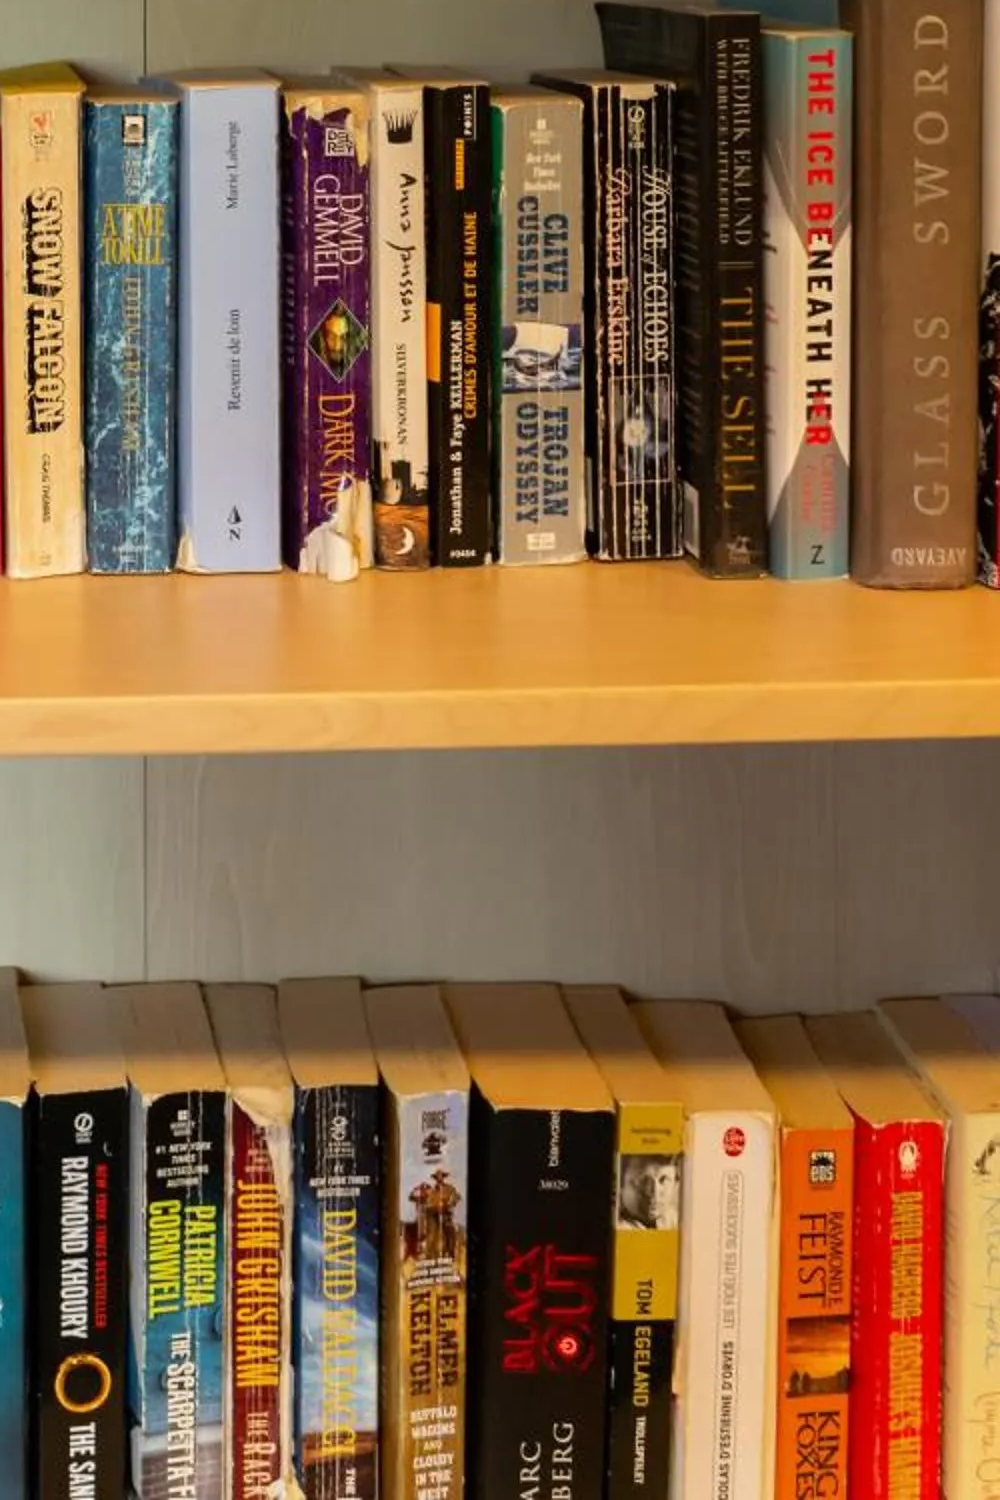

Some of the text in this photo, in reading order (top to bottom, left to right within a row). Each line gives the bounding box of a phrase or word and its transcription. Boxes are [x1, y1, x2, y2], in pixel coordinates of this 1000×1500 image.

[225, 121, 241, 211] Marie Laberge
[729, 37, 754, 247] FREDRIK EKLUND
[912, 13, 950, 246] SWORD
[311, 173, 341, 288] GEMMELL
[337, 193, 365, 267] DAVID
[385, 172, 420, 325] Anna Jansson
[515, 195, 541, 315] CUSSLER
[542, 212, 569, 295] CLIVE
[604, 164, 634, 367] Barbara Erskine
[805, 49, 835, 447] THE ICE BENEATH HER
[25, 186, 67, 435] SNOW FALCON
[226, 308, 242, 412] Revenir de loin
[462, 212, 477, 420] CRIMES D'AMOUR ET DE HAINE
[719, 286, 755, 381] THE
[317, 390, 356, 466] DARK
[393, 343, 411, 447] SILVERKRONAN
[448, 320, 466, 535] Jonathan & Faye KELLERMAN
[719, 392, 756, 510] SELL
[912, 316, 950, 518] GLASS
[515, 401, 541, 525] ODYSSEY
[543, 404, 569, 518] TROJAN
[891, 547, 967, 567] AVEYARD
[59, 1156, 89, 1339] RAYMOND KHOURY
[94, 1164, 107, 1329] NEW YORK TIMES BESTSELLER
[147, 1199, 181, 1320] CORNWELL
[183, 1205, 216, 1308] PATRICIA
[235, 1180, 280, 1387] JOHN GRISHAM
[321, 1208, 357, 1302] DAVID
[796, 1210, 827, 1314] FEIST
[408, 1291, 433, 1398] KELTON
[435, 1293, 459, 1387] ELMER
[502, 1245, 541, 1373] BLACK
[541, 1245, 598, 1372] OUT
[631, 1279, 654, 1408] TOM EGELAND
[164, 1332, 195, 1480] THE SCARPETTA
[320, 1310, 358, 1458] BALDACCI
[795, 1410, 818, 1500] FOXES
[814, 1409, 841, 1498] KING
